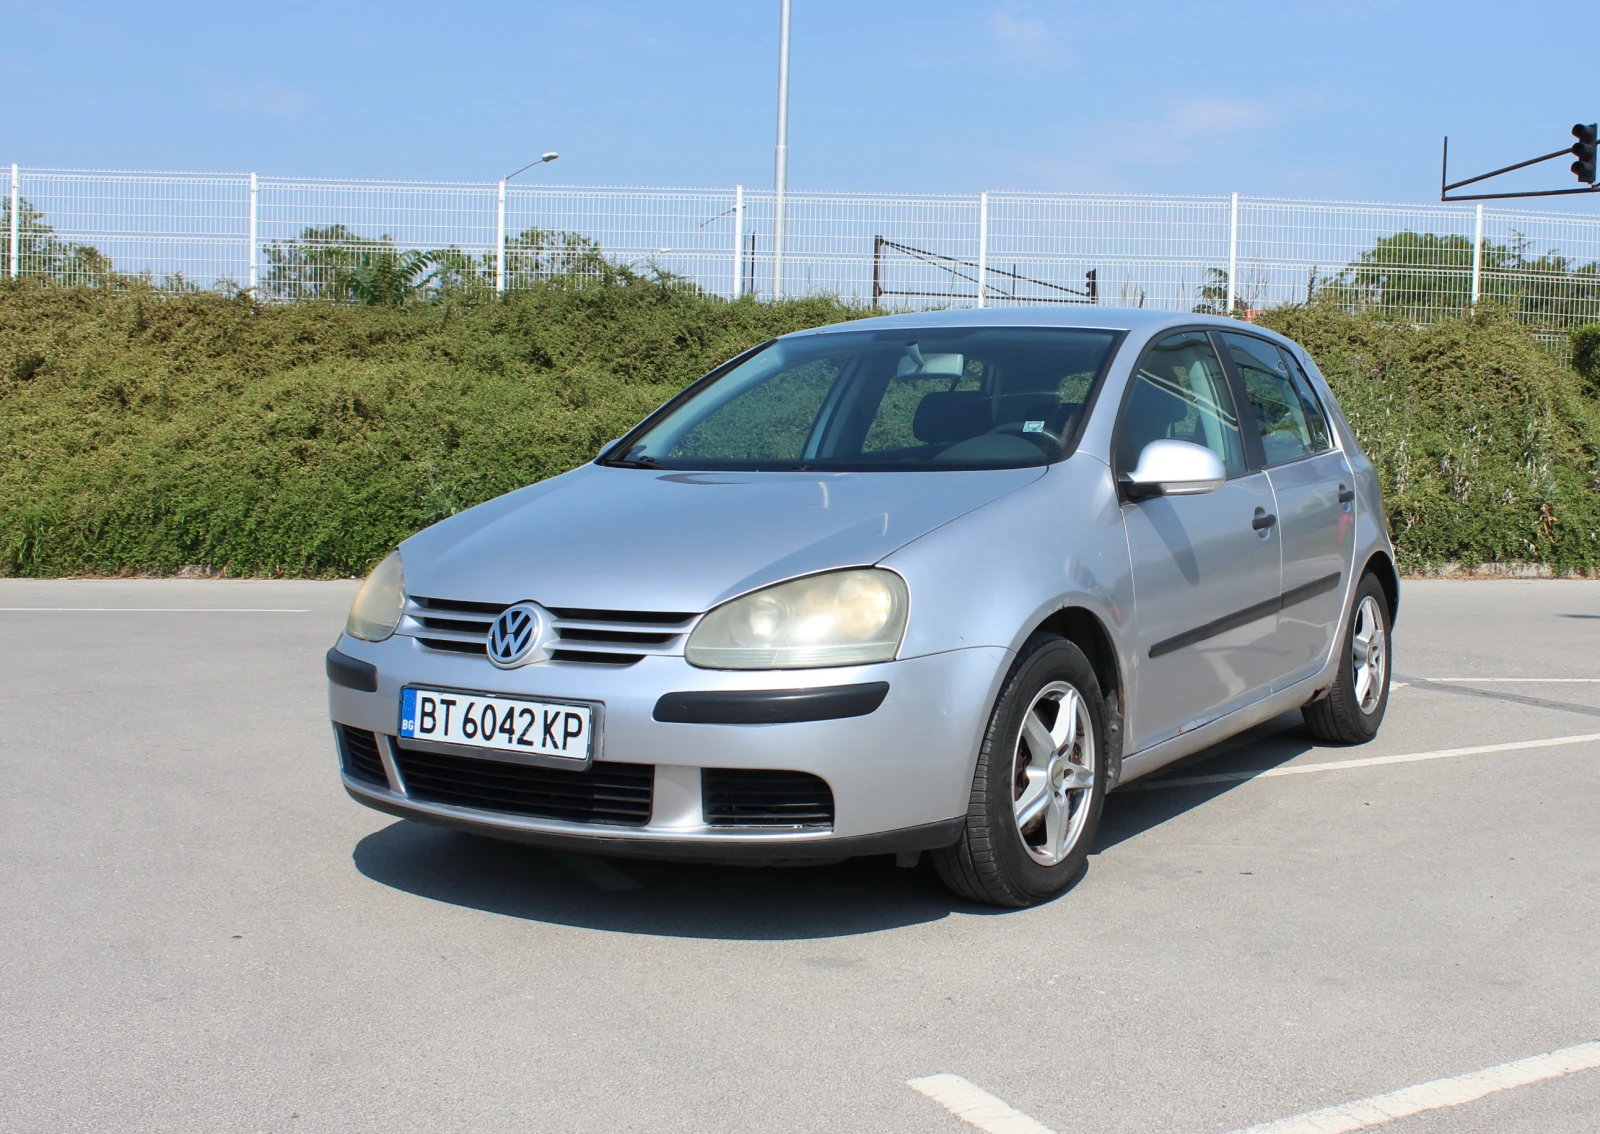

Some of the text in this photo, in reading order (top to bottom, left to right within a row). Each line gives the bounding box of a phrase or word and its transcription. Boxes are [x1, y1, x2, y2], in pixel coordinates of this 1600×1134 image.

[402, 719, 414, 730] BG
[420, 696, 583, 750] BT 6042 KP
